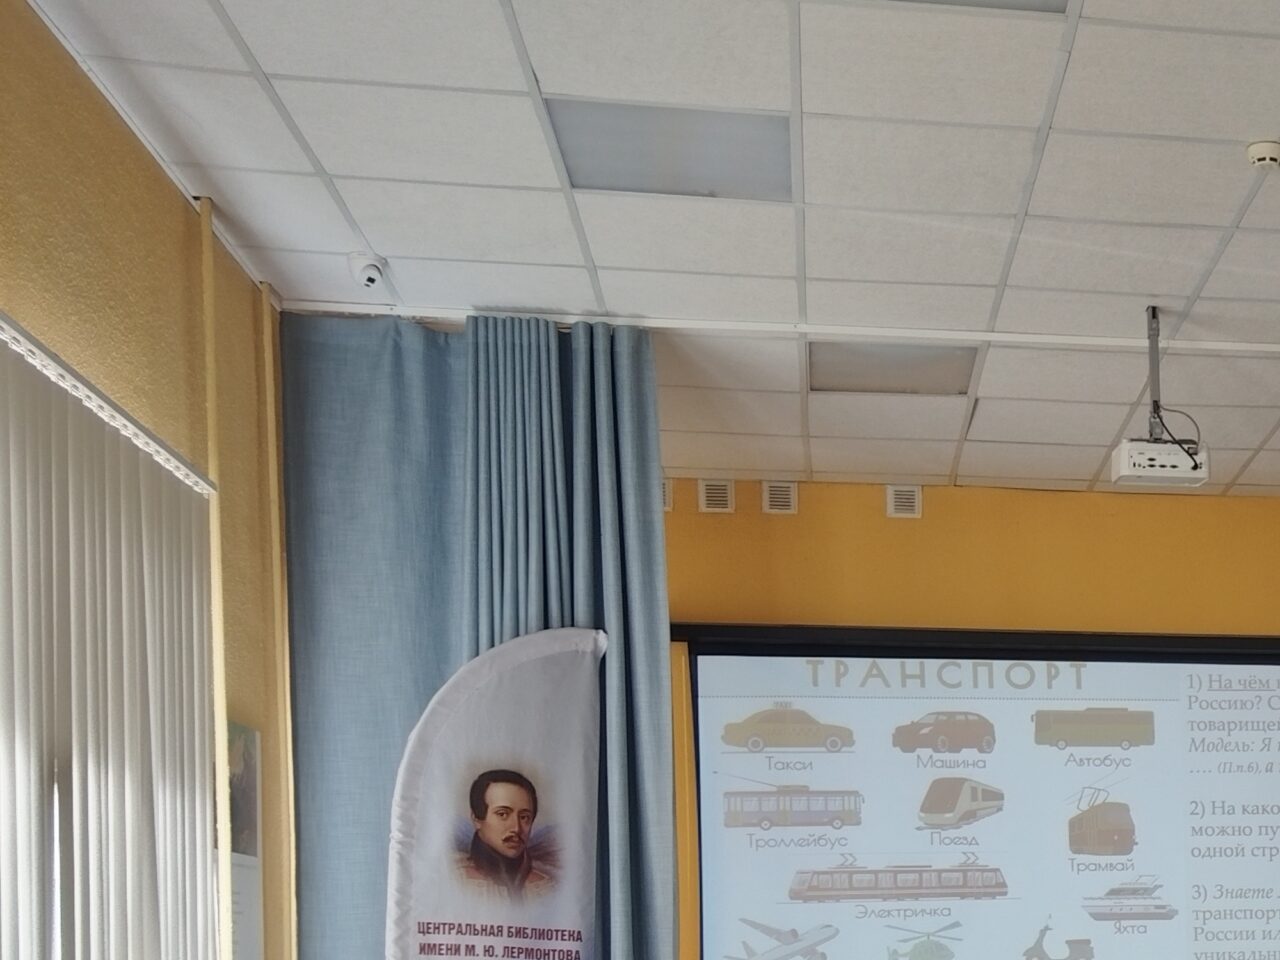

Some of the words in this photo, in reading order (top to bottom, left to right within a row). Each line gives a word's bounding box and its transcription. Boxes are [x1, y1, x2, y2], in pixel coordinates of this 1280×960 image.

[806, 659, 1087, 689] ТРАНСПОРТ
[1187, 674, 1202, 693] 1)
[1208, 674, 1233, 689] На
[1238, 675, 1270, 689] чём
[1187, 695, 1263, 711] Россию?
[1188, 737, 1256, 752] Модель:
[1260, 737, 1273, 752] Я
[765, 756, 813, 771] Такси
[917, 754, 987, 769] Машина
[1064, 753, 1132, 770] Автобус
[1265, 762, 1275, 774] а
[1189, 800, 1206, 820] 2)
[1210, 800, 1236, 815] На
[930, 831, 980, 846] Поезд
[1191, 825, 1253, 837] можно
[746, 833, 849, 851] Троллейбус
[1190, 843, 1246, 860] одной
[1068, 858, 1135, 875] Трамвай
[1191, 884, 1208, 904] 3)
[1212, 883, 1274, 900] Знаете
[855, 904, 951, 920] Электричка
[417, 922, 503, 938] ЦЕНТРАЛЬНАЯ
[507, 926, 583, 943] БИБЛИОТЕКА
[1114, 920, 1148, 935] Яхта
[1193, 926, 1256, 941] России
[419, 943, 461, 957] ИМЕНИ
[465, 944, 480, 957] М.
[484, 945, 499, 958] Ю.
